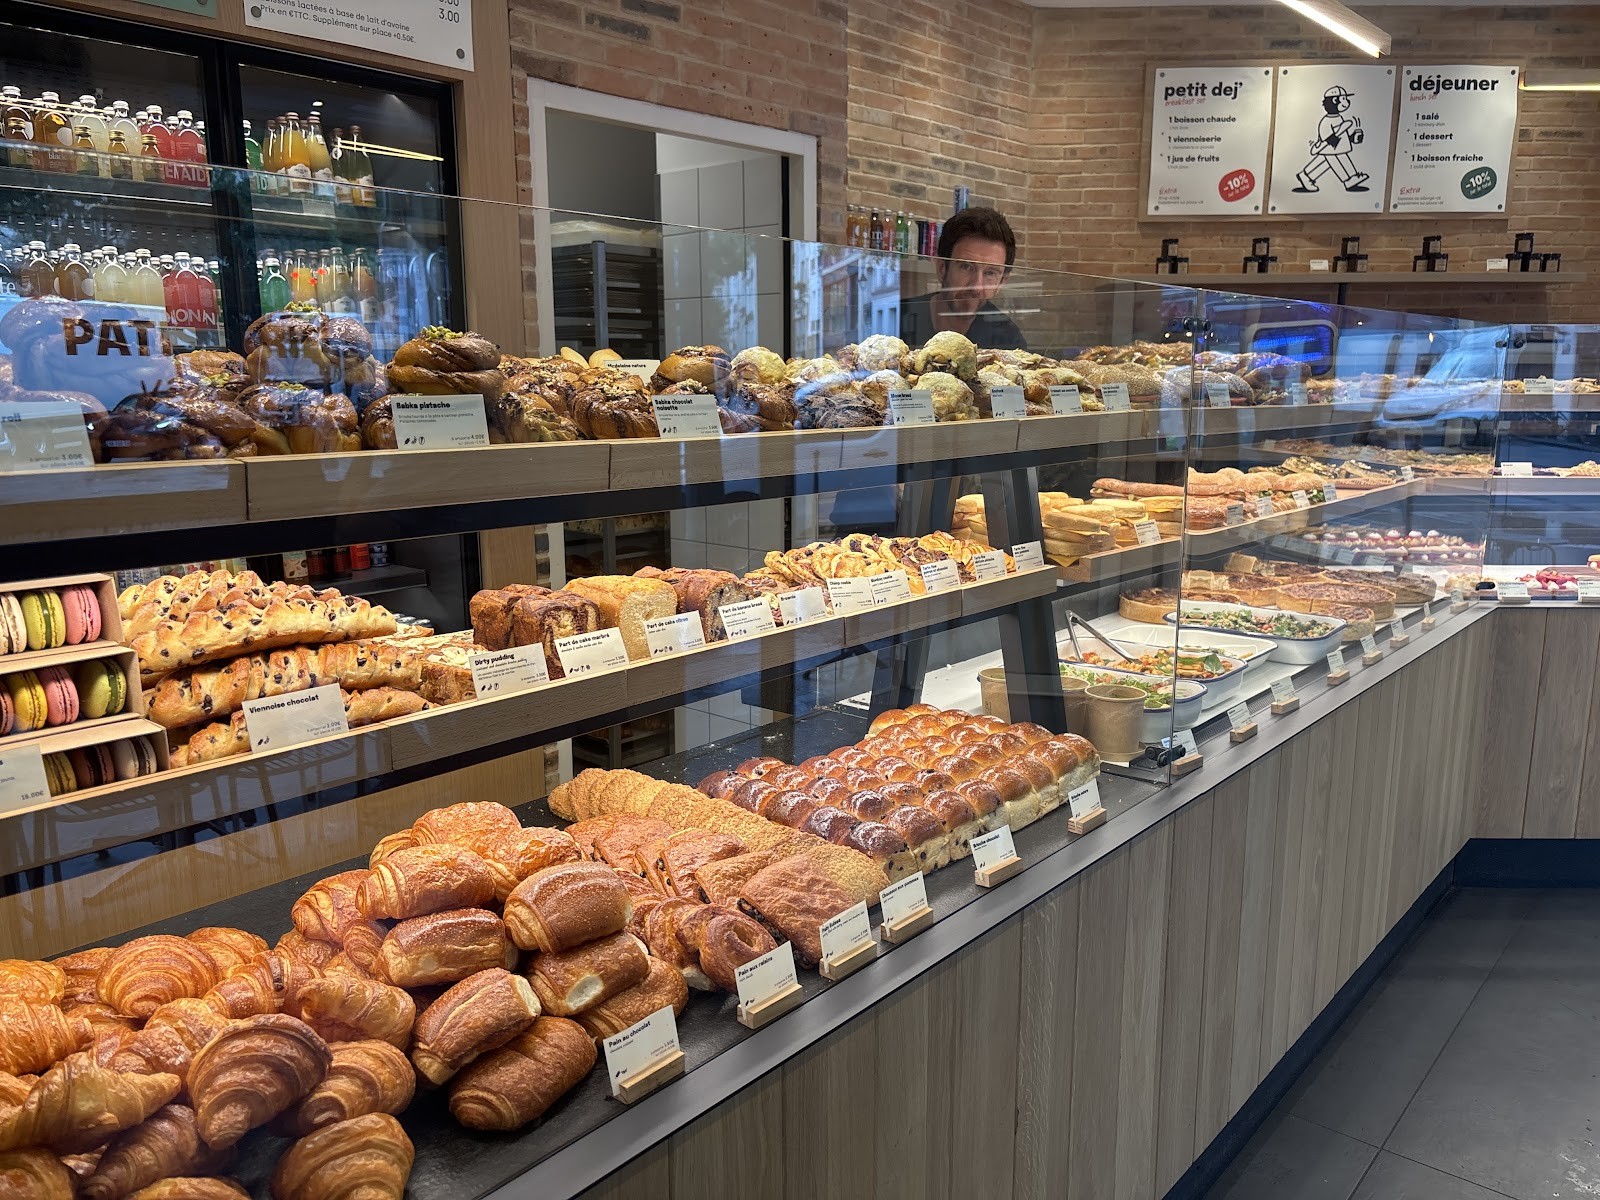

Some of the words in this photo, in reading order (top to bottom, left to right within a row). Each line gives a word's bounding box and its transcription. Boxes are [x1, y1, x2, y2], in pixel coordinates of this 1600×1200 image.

[298, 1, 327, 13] lactées
[329, 6, 334, 15] à
[336, 8, 355, 19] base
[356, 13, 365, 21] de
[367, 14, 380, 25] lait
[381, 19, 410, 32] d'avoine
[438, 7, 460, 23] 3.00
[260, 4, 276, 14] Prix
[289, 10, 311, 21] €TTC.
[312, 14, 358, 30] Supplément
[360, 24, 371, 33] sur
[372, 27, 392, 38] place
[1409, 75, 1500, 95] déjeuner
[1164, 82, 1207, 100] petit
[1165, 97, 1194, 107] breakfast
[1410, 93, 1427, 102] lunch
[1206, 115, 1236, 123] chaude
[1421, 112, 1440, 120] salé
[1173, 135, 1222, 143] viennoiserie
[1419, 132, 1454, 140] dessert
[1171, 155, 1184, 164] jus
[1197, 154, 1220, 162] fruits
[1417, 154, 1451, 162] boisson
[1223, 173, 1249, 191] -10%
[1465, 170, 1491, 189] -10%
[1159, 187, 1178, 196] Extra
[1399, 186, 1421, 195] Extra
[420, 401, 451, 410] pistache
[592, 633, 610, 641] marbré
[475, 658, 490, 666] Dirty
[491, 654, 515, 664] pudding
[249, 702, 285, 714] Viennoise
[287, 694, 319, 707] chocolat
[21, 790, 44, 801] 15.00€
[738, 968, 749, 977] Pain
[749, 964, 758, 972] aux
[758, 956, 773, 966] raisins
[608, 1038, 622, 1048] Pain
[630, 1020, 651, 1037] chocolat
